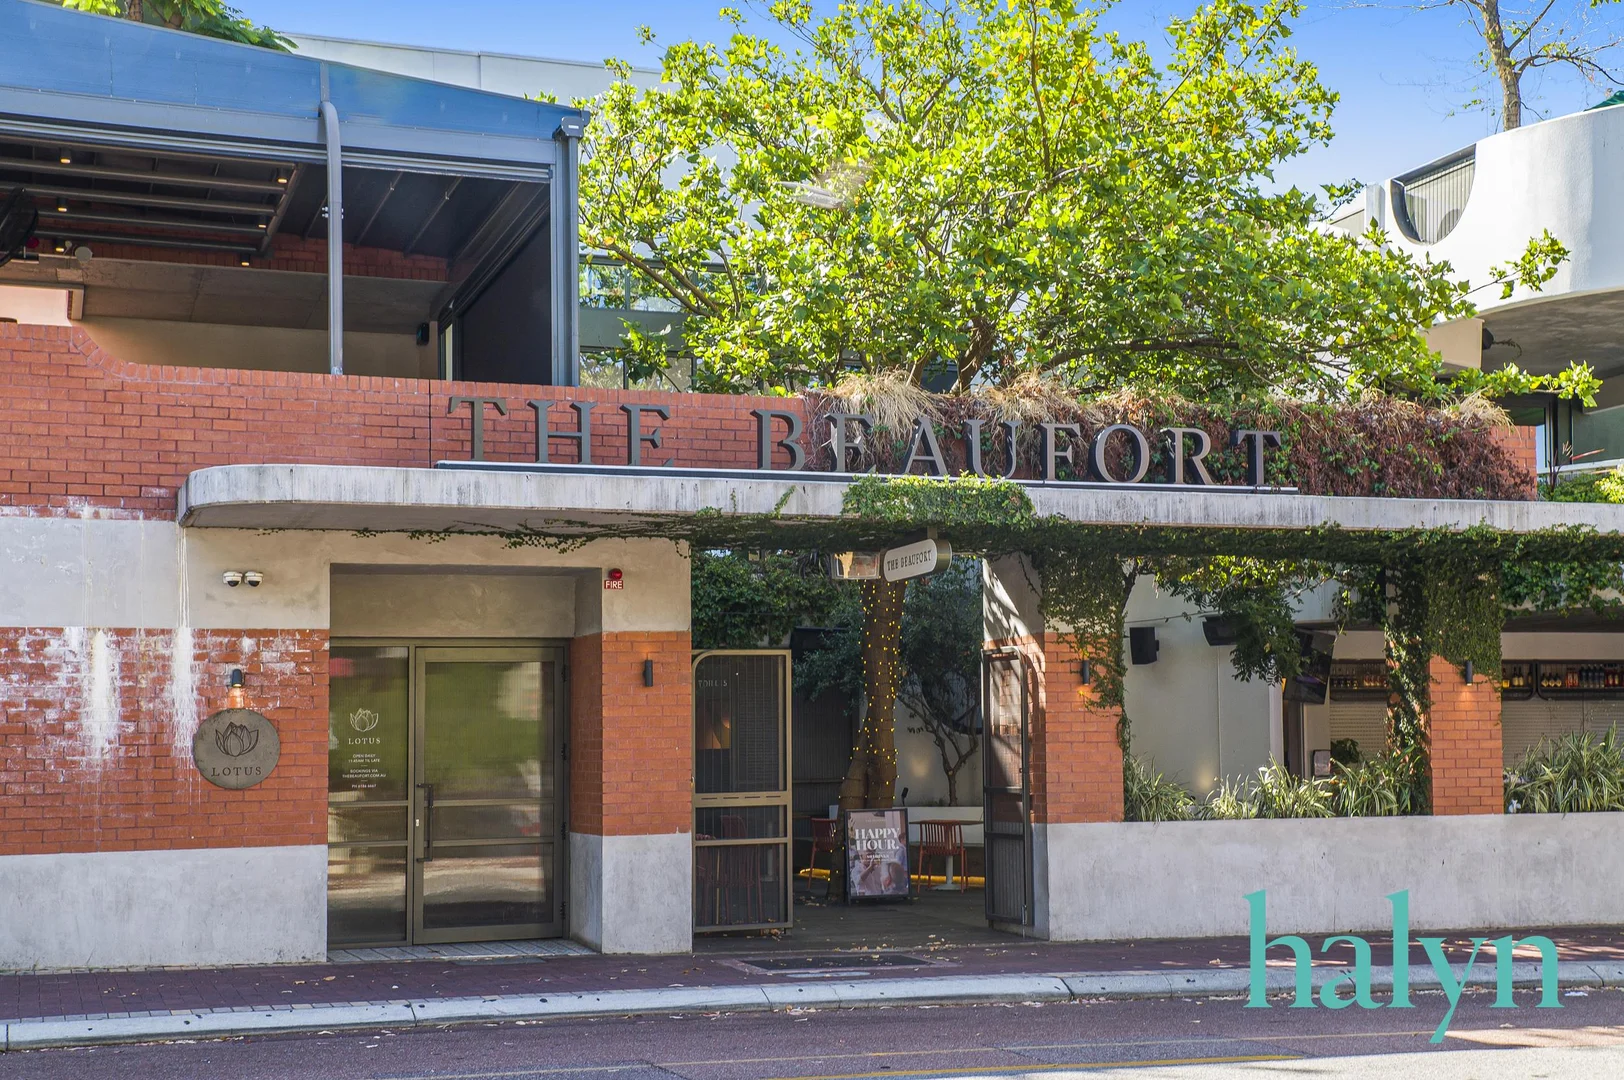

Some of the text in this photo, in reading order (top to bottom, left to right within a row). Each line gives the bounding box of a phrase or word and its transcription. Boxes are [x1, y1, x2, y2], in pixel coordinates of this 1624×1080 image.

[448, 396, 1282, 489] THE BEAUFORT
[887, 549, 932, 571] THE BEAUFORT
[605, 580, 623, 589] FIRE
[348, 737, 381, 745] LOTUS
[211, 766, 262, 777] LOTUS
[855, 828, 900, 840] HAPPY
[856, 839, 899, 851] HOUR.
